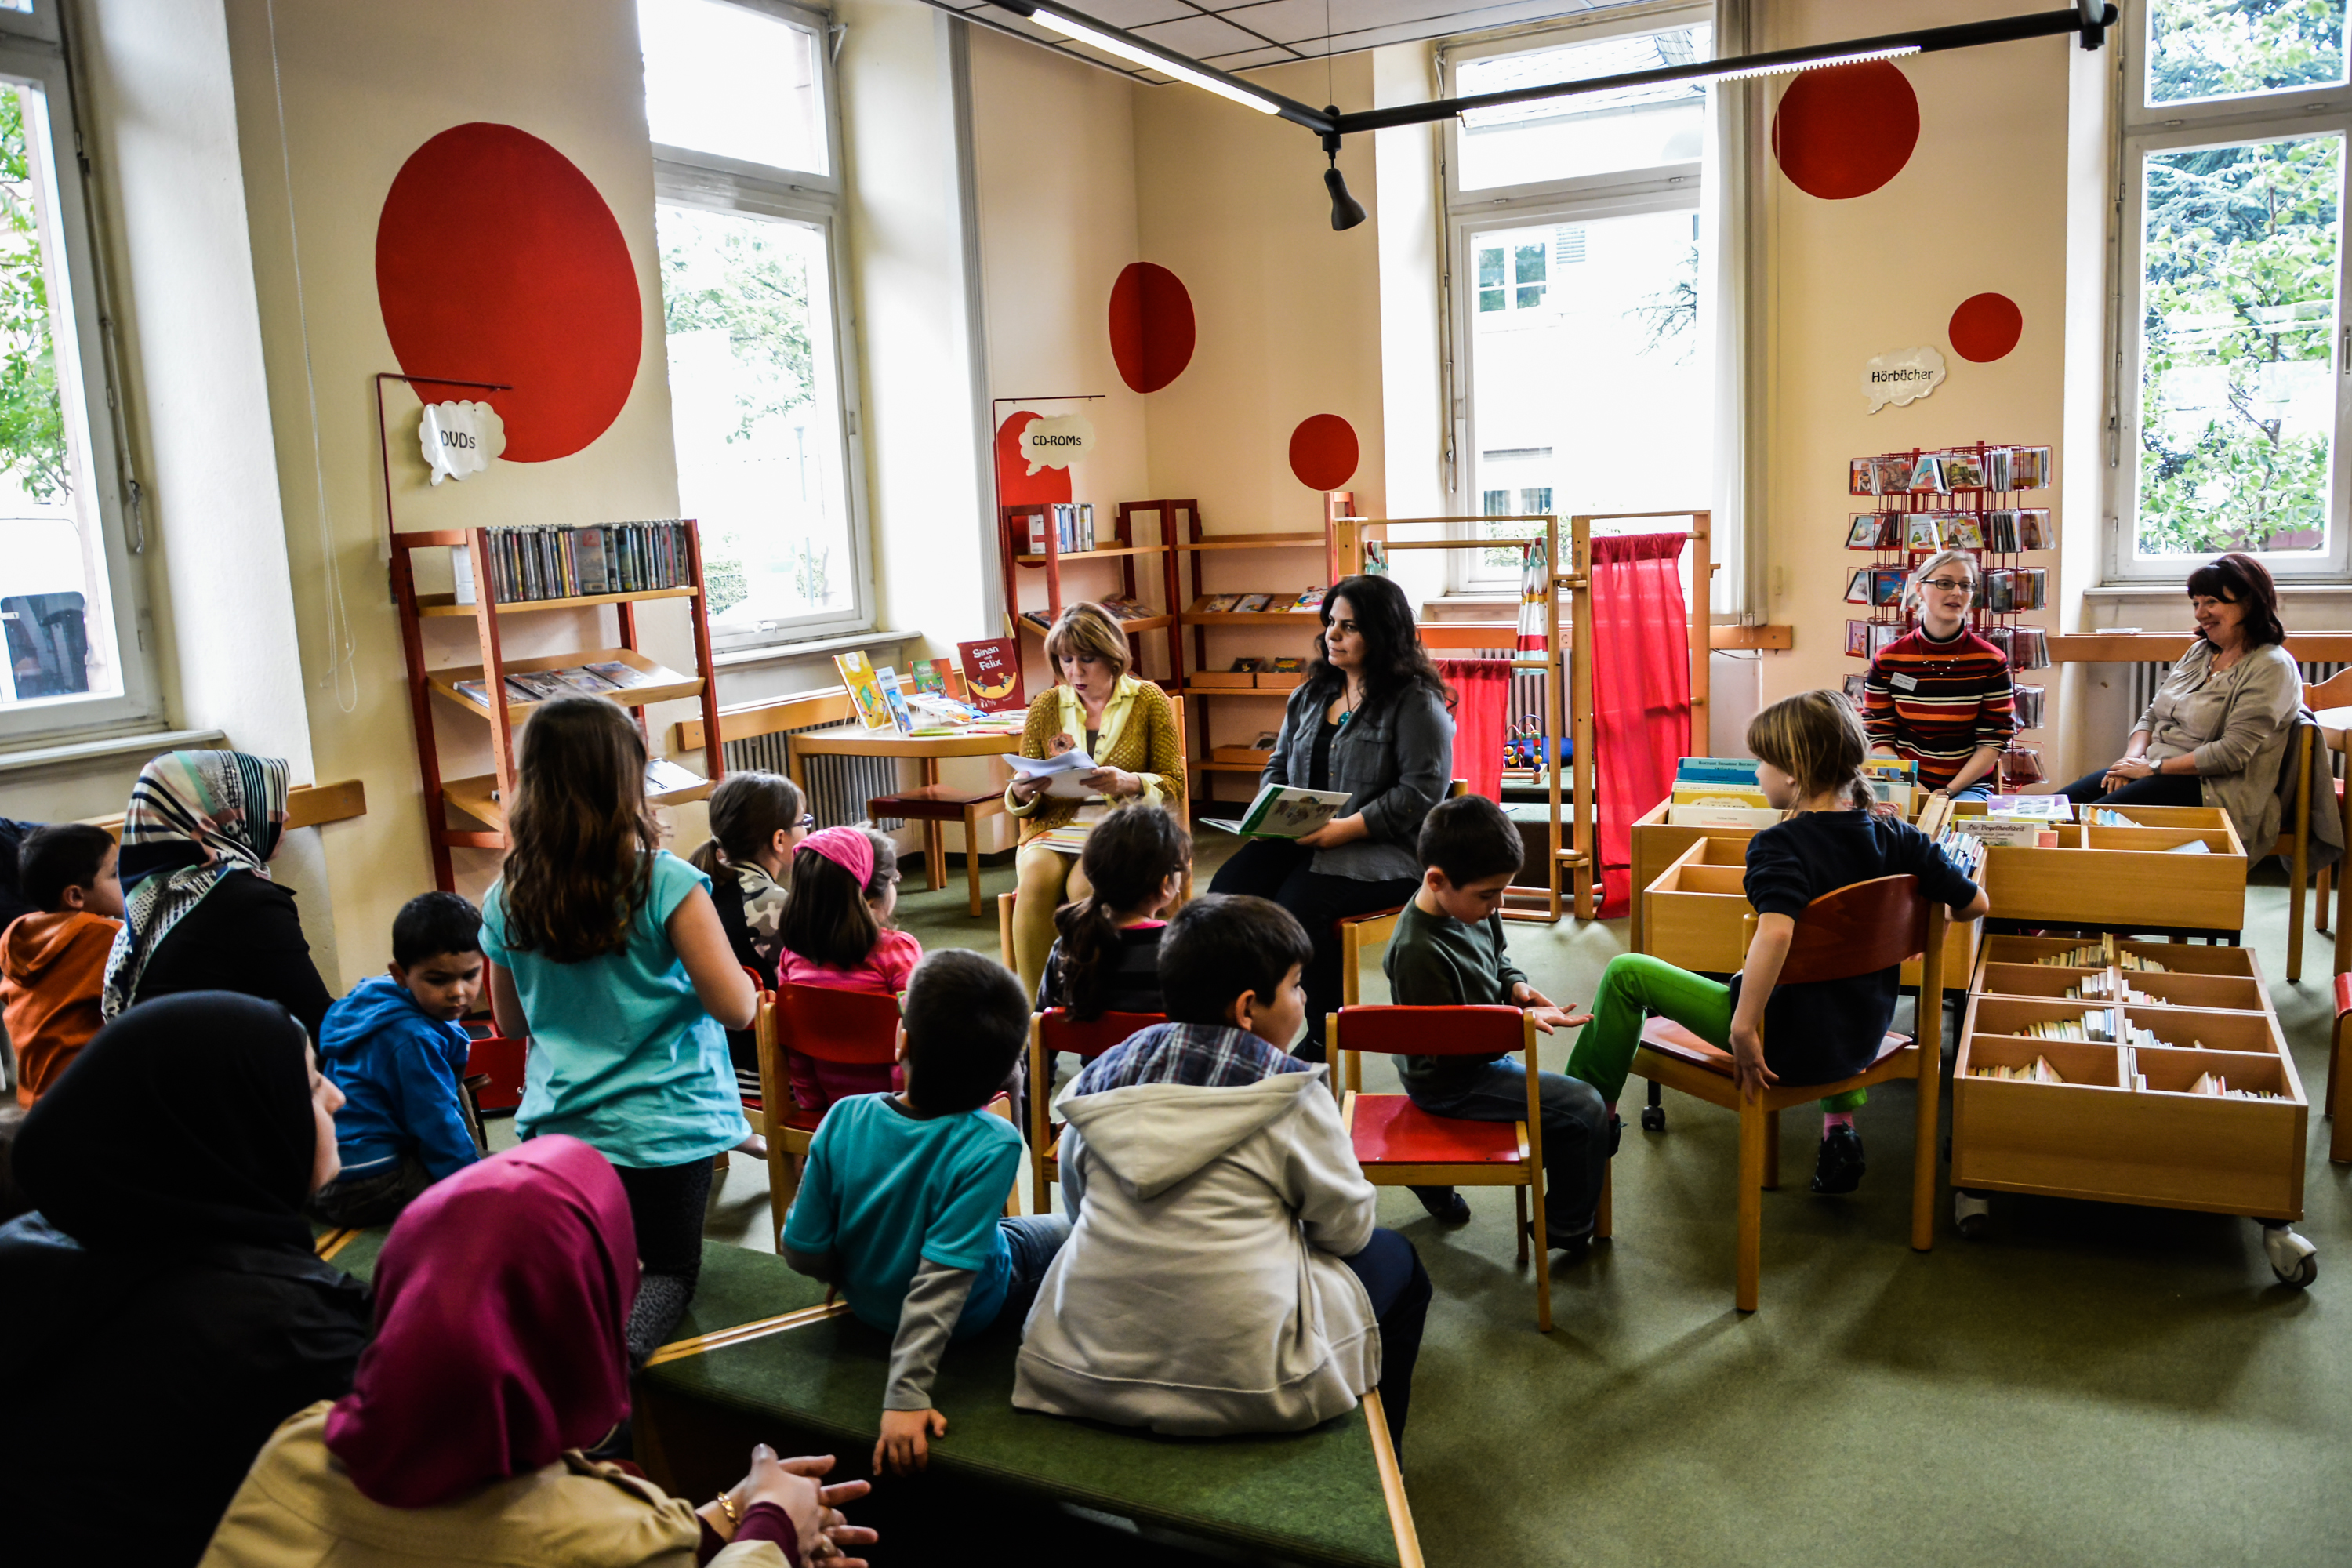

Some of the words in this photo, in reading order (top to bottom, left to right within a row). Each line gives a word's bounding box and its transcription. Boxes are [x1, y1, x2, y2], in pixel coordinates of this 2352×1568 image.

[1871, 369, 1933, 383] Hörbücher
[441, 430, 476, 449] DVDs
[1032, 435, 1082, 446] CD-ROMs
[972, 646, 1000, 659] Sinan
[978, 659, 1003, 670] Felix
